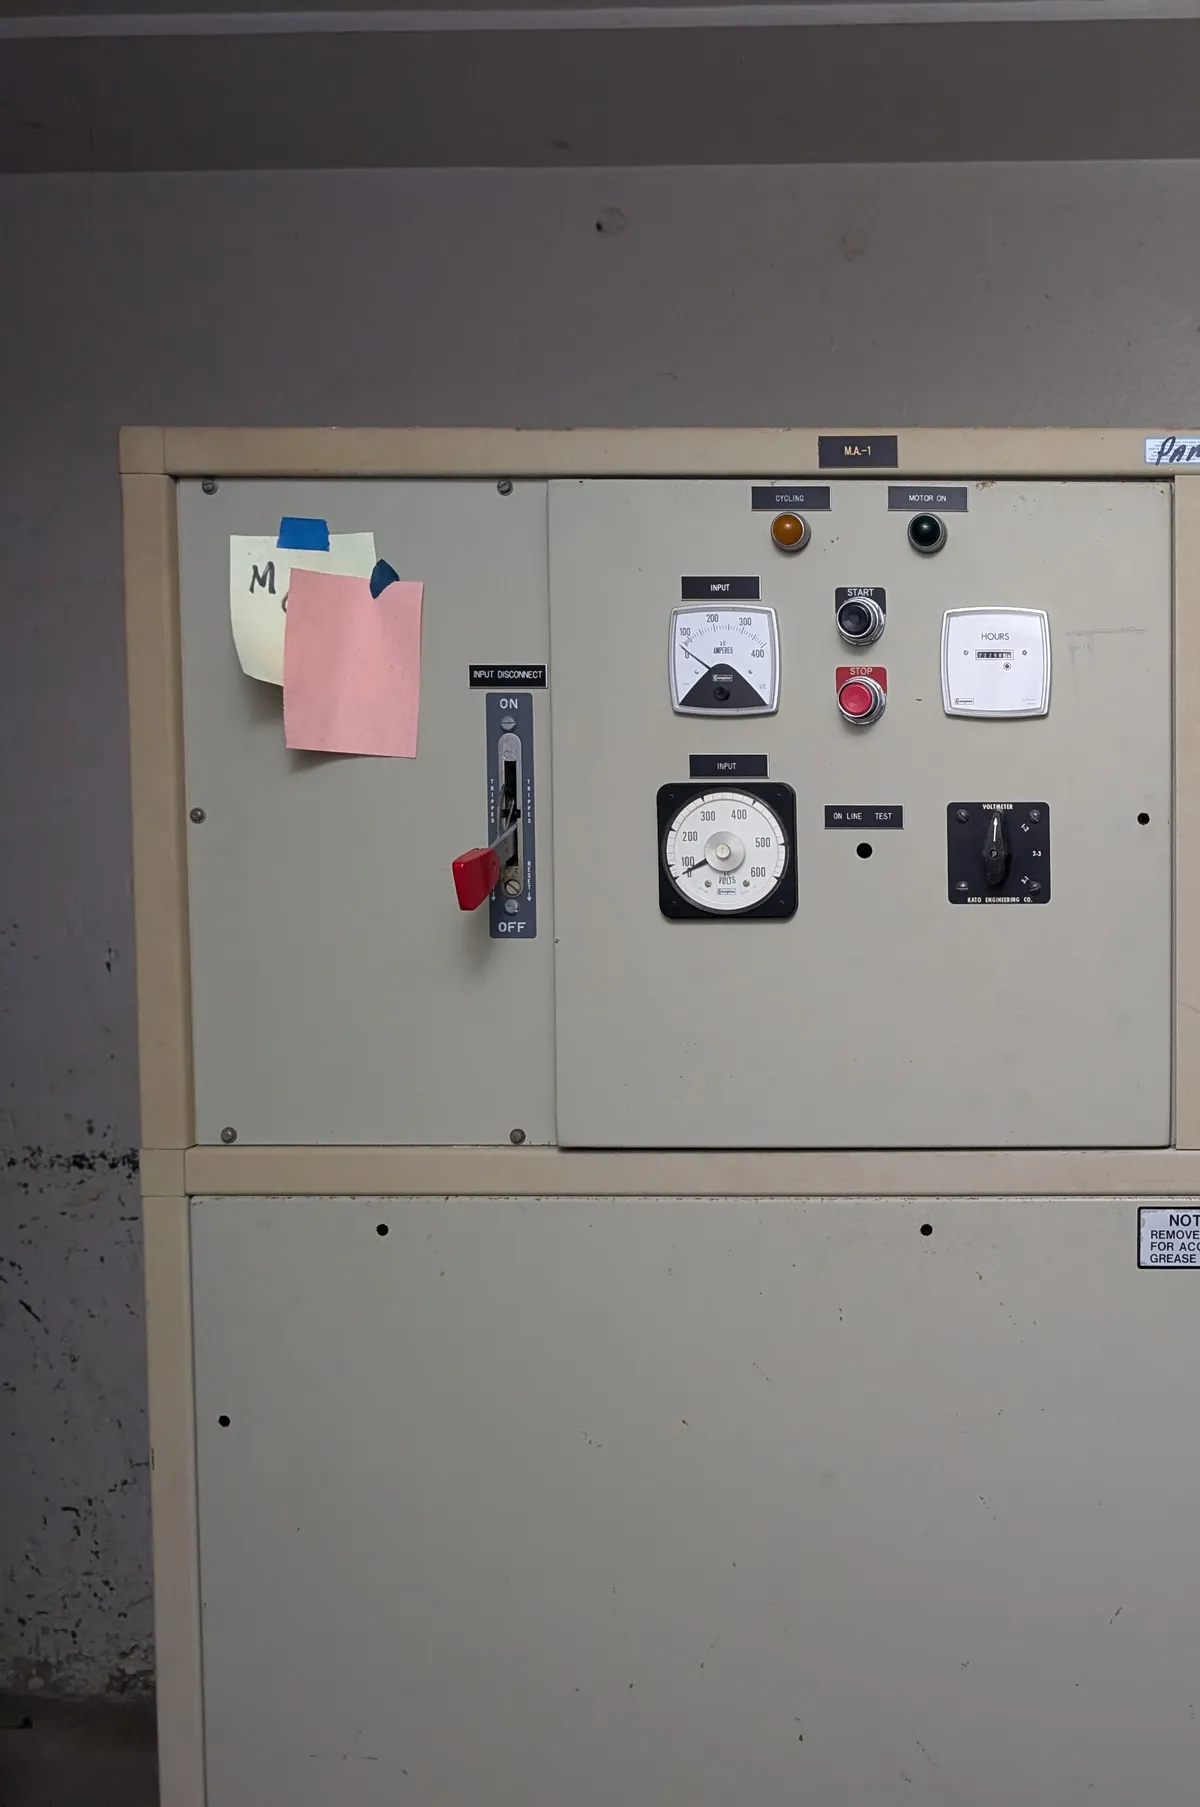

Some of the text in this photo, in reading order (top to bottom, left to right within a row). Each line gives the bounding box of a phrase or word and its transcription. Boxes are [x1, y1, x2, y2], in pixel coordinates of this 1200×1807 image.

[844, 446, 871, 456] M.A.-1
[775, 494, 804, 502] CYCLING
[908, 494, 947, 502] MOTOR ON
[710, 584, 730, 592] INPUT
[847, 588, 874, 597] START
[706, 614, 719, 623] 200
[738, 617, 752, 626] 300
[679, 627, 691, 637] 100
[981, 632, 1010, 641] HOURS
[713, 646, 733, 654] AMPERES
[750, 649, 764, 658] 400
[473, 671, 543, 679] INPUT DISCONNECT
[850, 667, 873, 675] STOP
[500, 698, 519, 709] ON
[717, 762, 737, 770] INPUT
[700, 811, 716, 821] 300
[731, 809, 747, 820] 400
[833, 812, 892, 820] ON LINE TEST
[682, 831, 698, 842] 200
[755, 837, 771, 848] 500
[681, 856, 695, 867] 100
[750, 867, 766, 878] 600
[718, 876, 736, 885] VOLTS
[498, 921, 527, 933] OFF
[1150, 1230, 1200, 1240] REMOVE
[1150, 1242, 1174, 1251] FOR
[1149, 1253, 1196, 1264] GREASE
